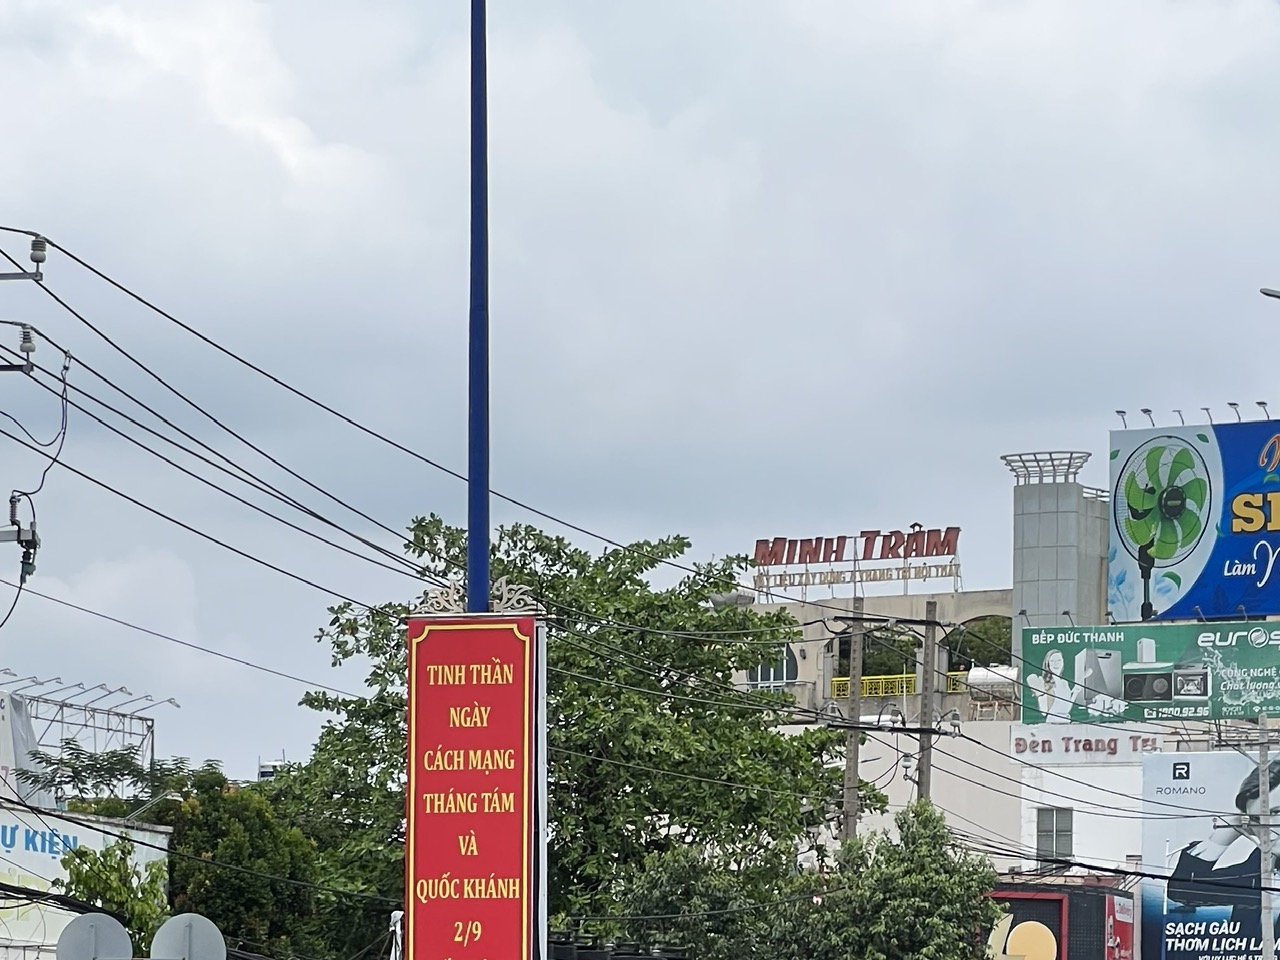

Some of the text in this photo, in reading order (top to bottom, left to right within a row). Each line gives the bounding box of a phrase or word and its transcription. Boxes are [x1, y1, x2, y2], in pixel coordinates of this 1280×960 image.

[754, 535, 848, 566] MINH
[1224, 560, 1256, 577] Làm
[1032, 629, 1124, 644] BẾP ĐỨC THANH
[426, 656, 514, 686] TINH THẦN
[449, 702, 492, 728] NGÀY
[1015, 732, 1053, 754] Đèn
[1062, 736, 1118, 755] Trang
[423, 745, 515, 775] CÁCH MẠNG
[423, 786, 515, 814] THÁNG TÁM
[1156, 786, 1206, 796] ROMANO
[0, 825, 79, 860] Ự KIỆN
[458, 830, 479, 856] VÀ
[416, 872, 520, 903] QUỐC KHÁNH
[454, 921, 483, 945] 2/9
[1165, 919, 1241, 937] SẠCH GÀU
[1165, 937, 1209, 951] THƠM
[1212, 937, 1247, 954] LỊCH
